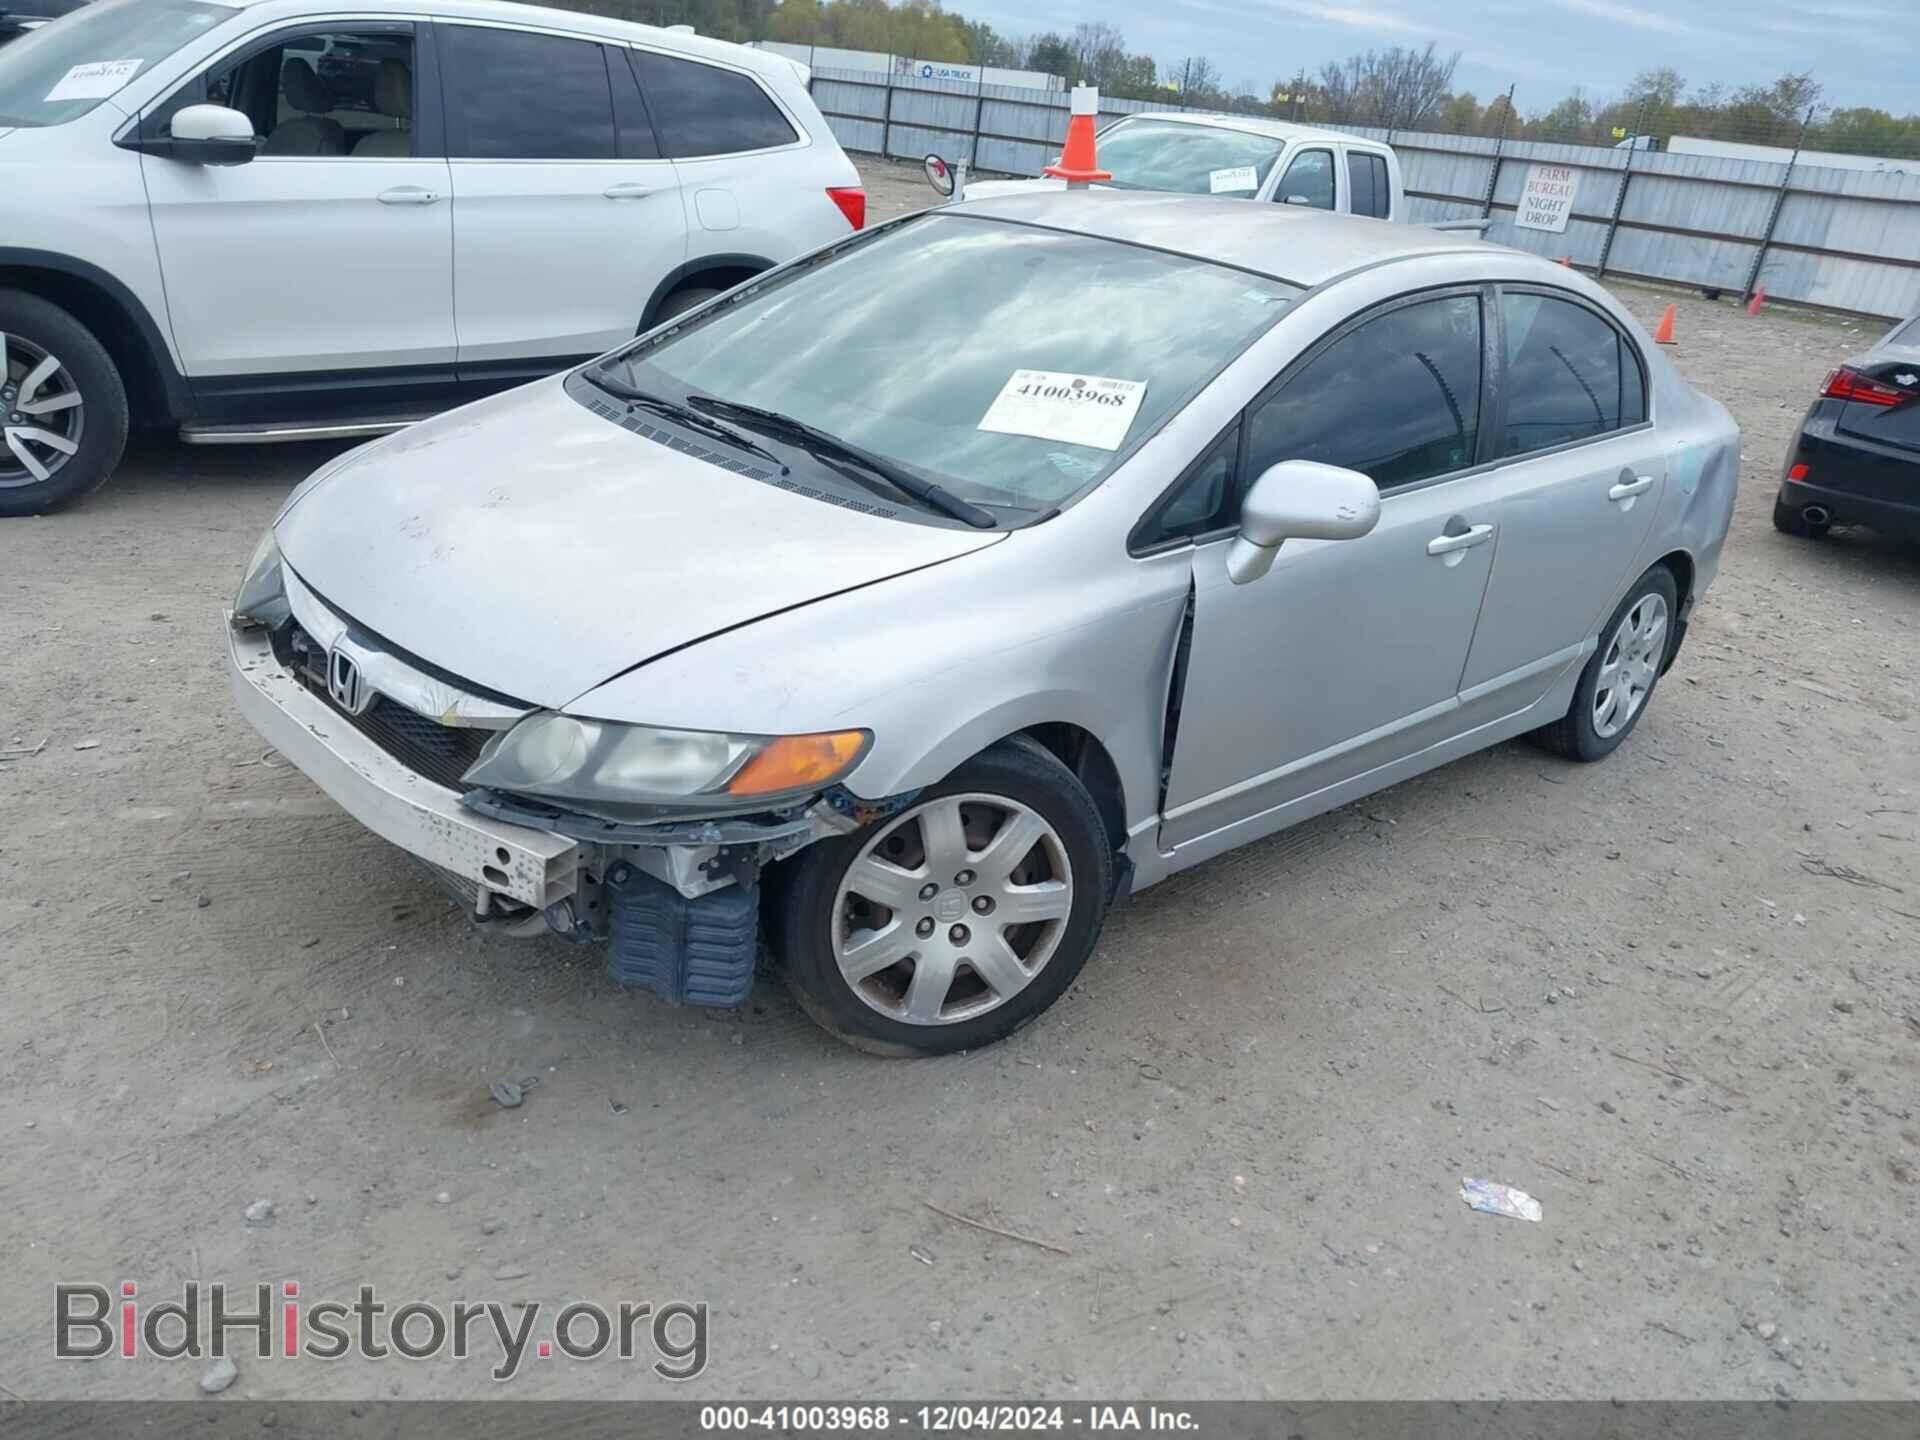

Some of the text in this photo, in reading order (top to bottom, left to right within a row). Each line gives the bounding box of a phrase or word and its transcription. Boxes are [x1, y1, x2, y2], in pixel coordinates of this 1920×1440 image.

[1538, 167, 1570, 181] FARM
[1527, 196, 1566, 212] NIGHT
[1526, 210, 1559, 225] DROP
[1017, 383, 1126, 407] 41003968
